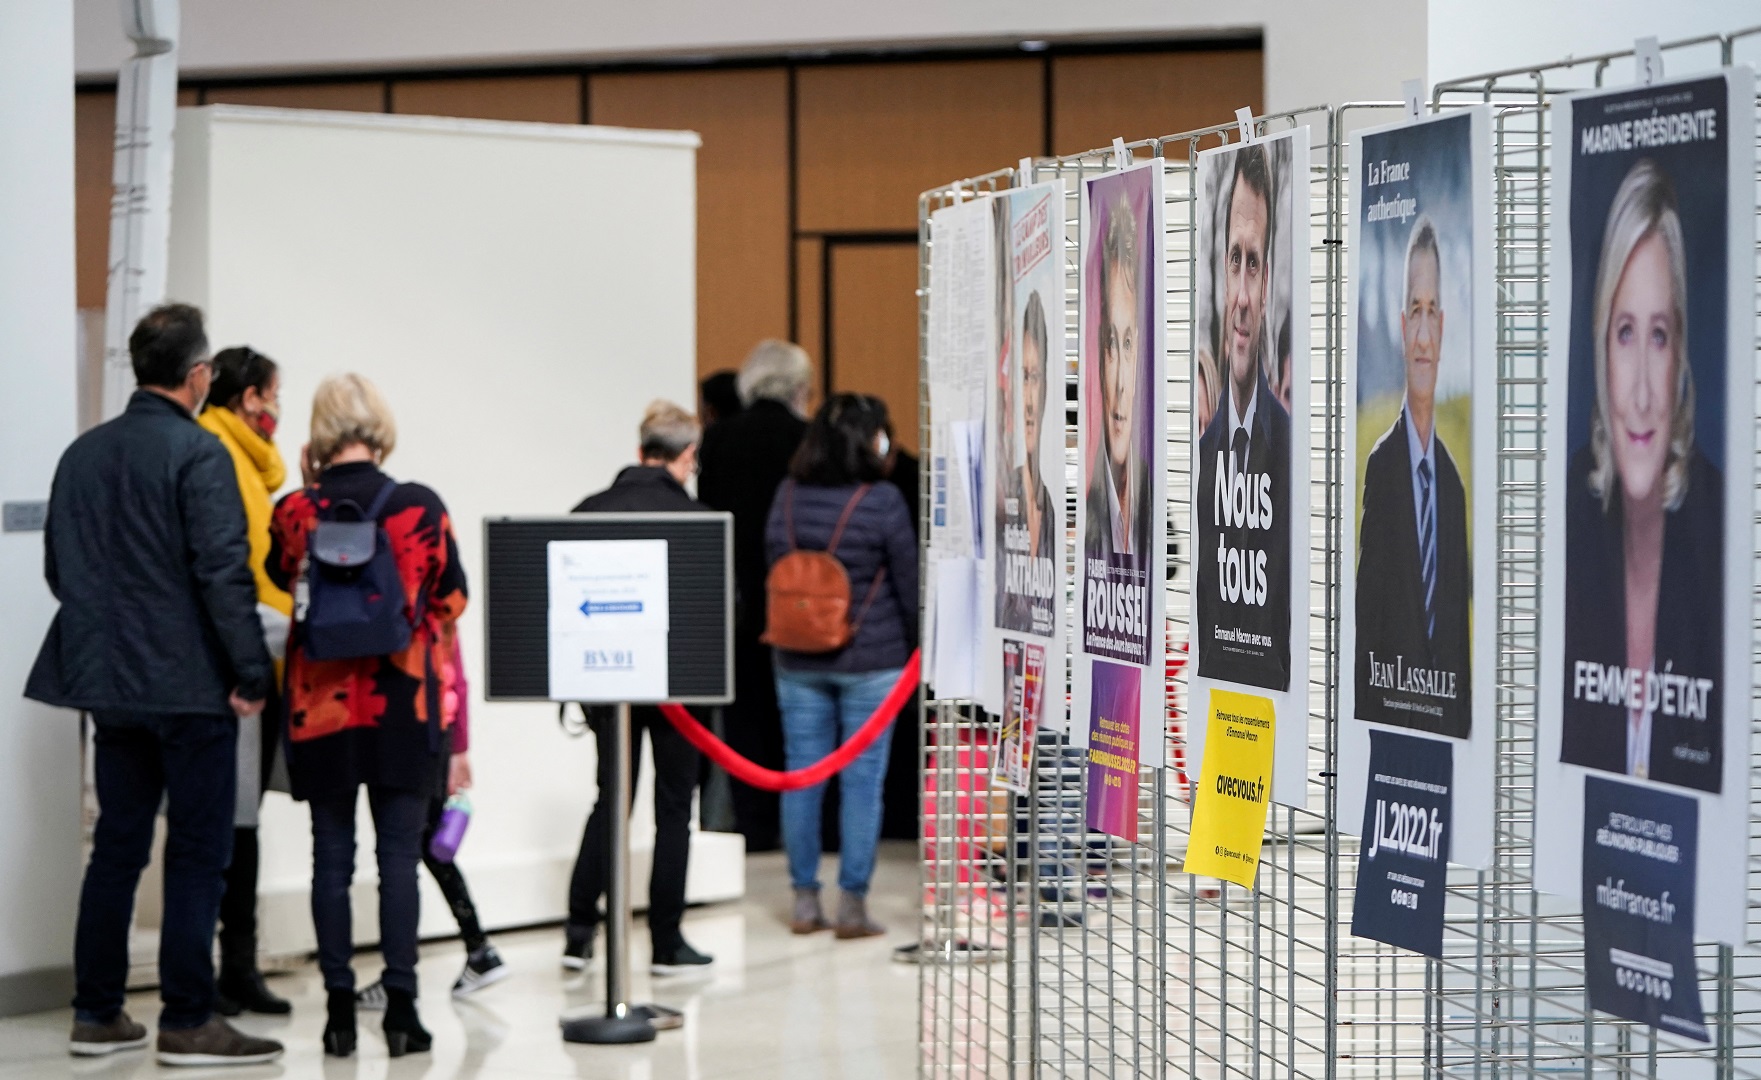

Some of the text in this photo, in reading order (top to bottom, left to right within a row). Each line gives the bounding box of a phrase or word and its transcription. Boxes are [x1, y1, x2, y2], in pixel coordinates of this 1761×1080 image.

[1244, 122, 1250, 144] 3
[1580, 106, 1717, 155] MARINE PRÉSIDENTE
[1367, 160, 1410, 187] La France
[1367, 192, 1417, 224] authentique
[1214, 450, 1273, 530] Nous
[1004, 553, 1055, 600] ARTHAUD
[1087, 557, 1107, 579] FABIEN
[1217, 532, 1269, 607] tous
[1086, 578, 1148, 638] ROUSSEL
[1092, 632, 1107, 649] France
[1106, 634, 1114, 651] des
[1214, 624, 1273, 648] Emmanuel Macron avec vous
[1368, 651, 1457, 699] JEAN LASSALLE
[1573, 659, 1714, 722] FEMME D'ÉTAT
[1215, 708, 1232, 722] Retrouvez
[1244, 716, 1270, 729] rassemblements
[1245, 730, 1259, 742] Macron
[1216, 773, 1265, 804] avecvous.fr
[1367, 799, 1443, 860] JL2022.fr
[1596, 876, 1676, 925] mlafrance.fr
